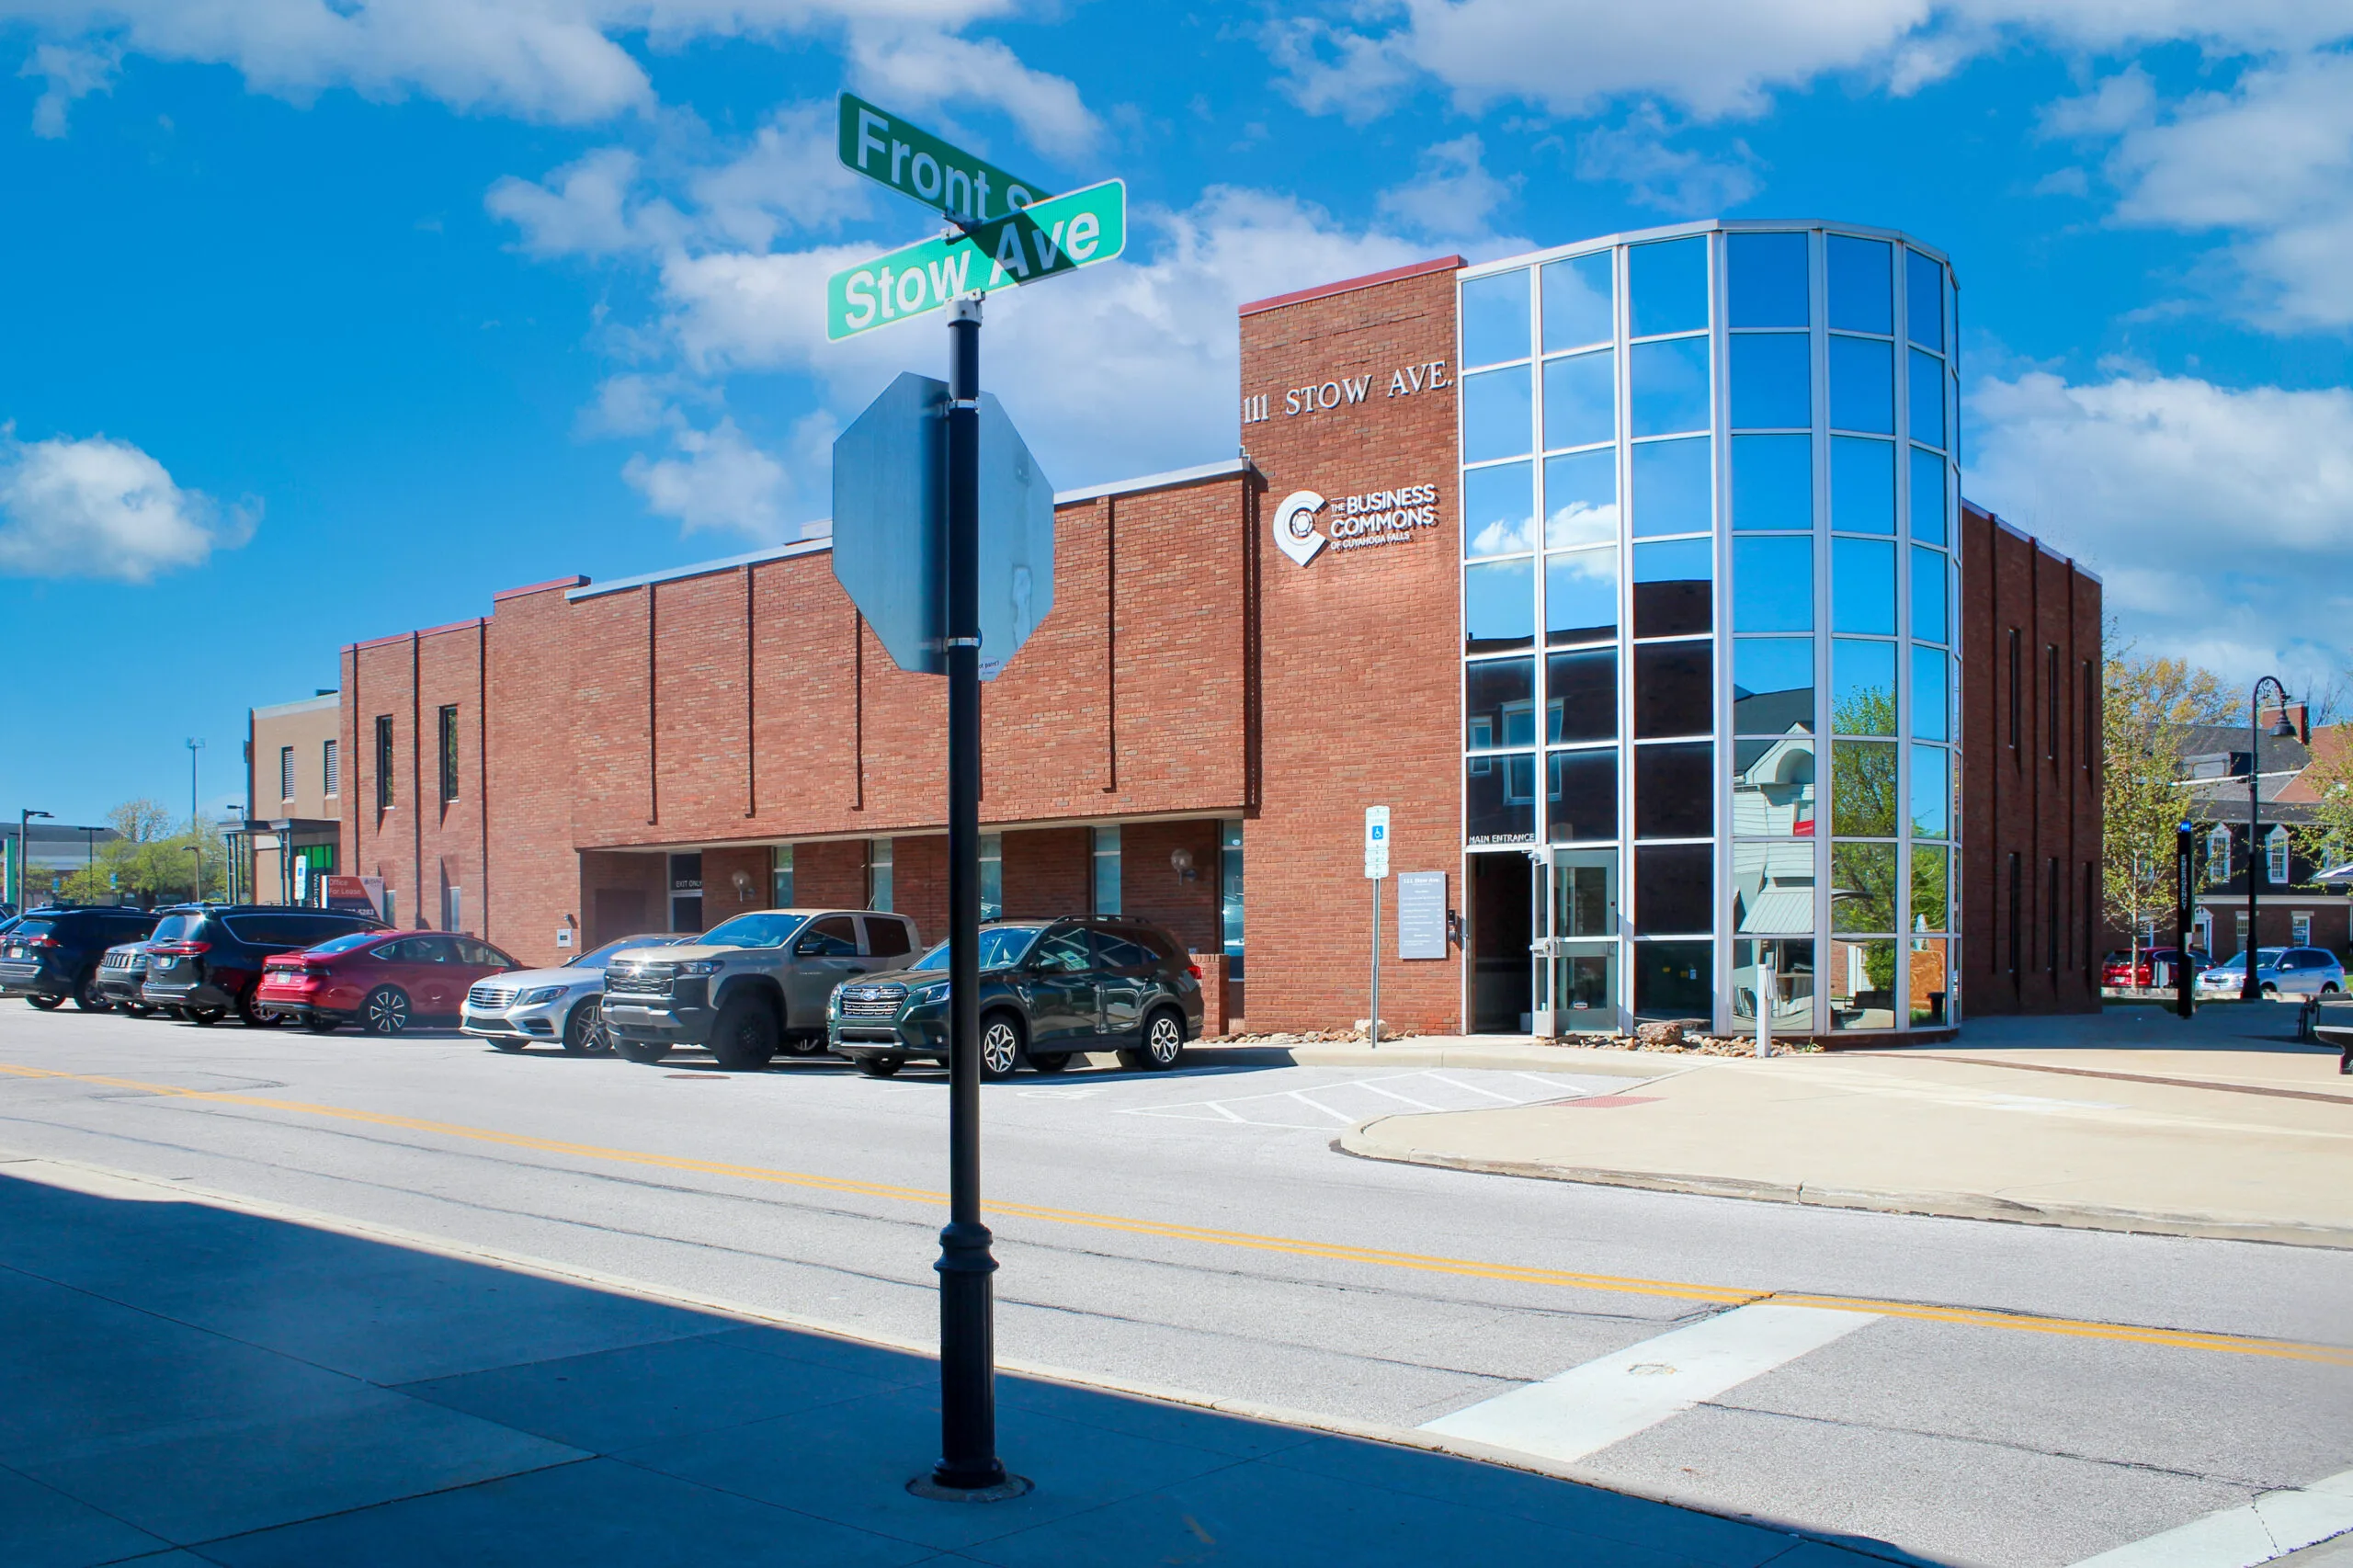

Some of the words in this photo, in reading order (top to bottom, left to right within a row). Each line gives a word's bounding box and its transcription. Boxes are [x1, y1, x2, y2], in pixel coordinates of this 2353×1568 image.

[857, 107, 990, 223] Front
[845, 250, 972, 328] Stow
[988, 212, 1100, 284] Ave
[1244, 393, 1269, 424] 111
[1286, 374, 1372, 415] STOW
[1387, 360, 1453, 398] AVE.
[1330, 504, 1345, 512] THE
[1347, 483, 1437, 515] BUSINESS
[1330, 506, 1436, 538] COMMONS
[1330, 540, 1342, 550] OF
[1343, 535, 1386, 548] CUYAHOGA
[1387, 531, 1410, 541] FALLS
[1469, 835, 1490, 844] MAIN
[1492, 833, 1535, 843] ENTRANCE
[329, 878, 348, 886] Office
